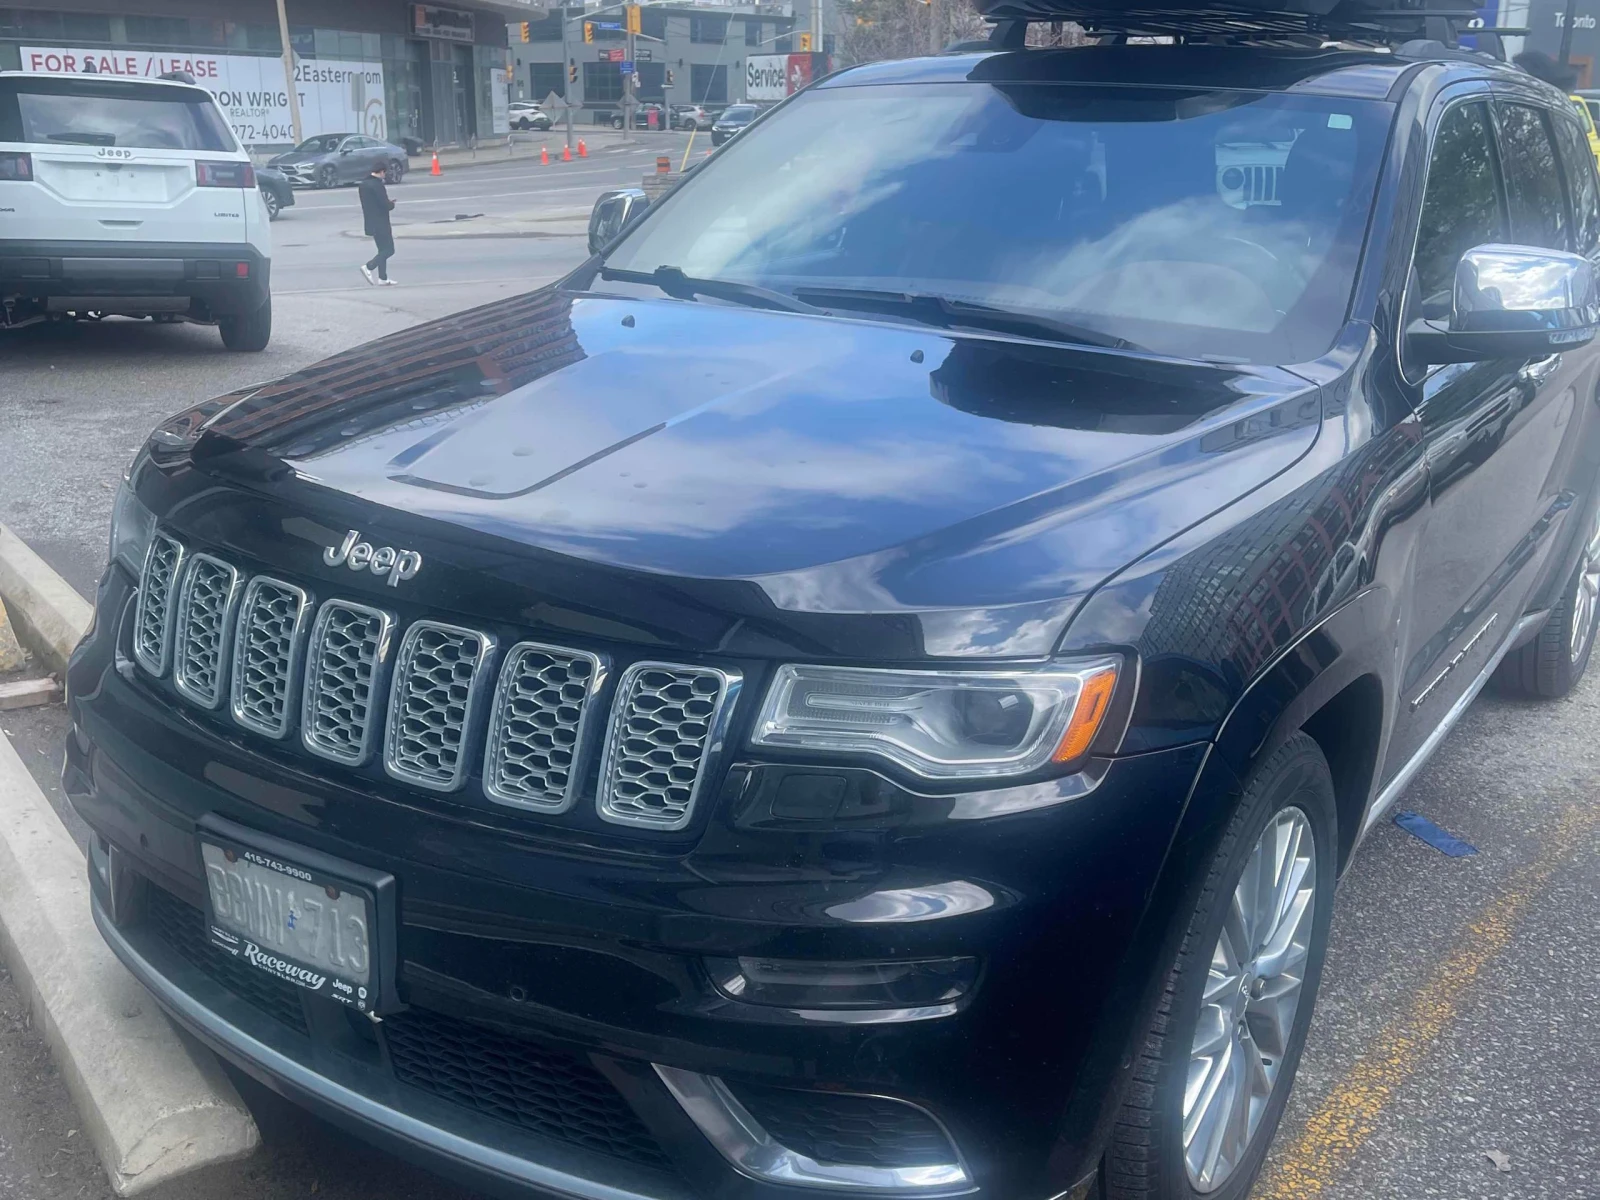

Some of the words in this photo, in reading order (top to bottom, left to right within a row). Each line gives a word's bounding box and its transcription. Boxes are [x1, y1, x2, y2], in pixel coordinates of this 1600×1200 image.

[1554, 12, 1597, 29] Toonto
[30, 54, 77, 72] FOR
[160, 58, 218, 77] LEASE
[747, 62, 785, 88] Service
[247, 91, 306, 108] WRIGT
[98, 149, 131, 159] Jeep
[323, 529, 422, 588] Jeep
[244, 851, 313, 882] 416-743-9900
[243, 939, 327, 990] Raceway
[332, 978, 353, 995] Jeep
